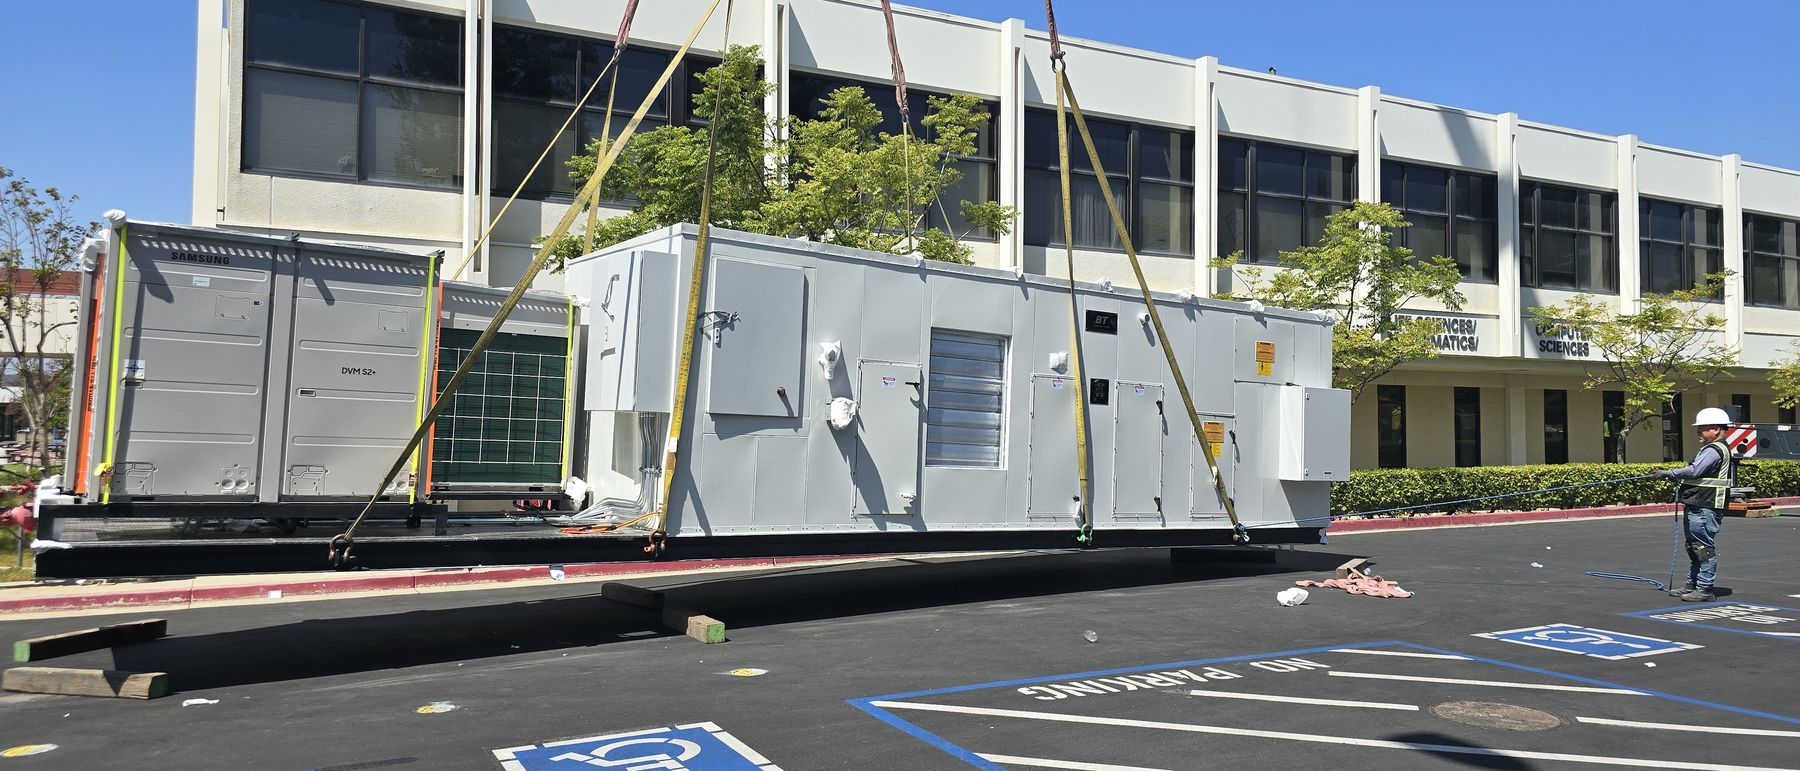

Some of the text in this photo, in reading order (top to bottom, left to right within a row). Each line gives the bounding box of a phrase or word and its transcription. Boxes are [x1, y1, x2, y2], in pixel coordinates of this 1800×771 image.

[171, 252, 230, 265] SAMSUNG
[1095, 315, 1109, 325] BT
[1539, 340, 1590, 357] SCIENCES
[341, 366, 377, 376] DVM S2+
[1017, 657, 1331, 701] NO PARKING
